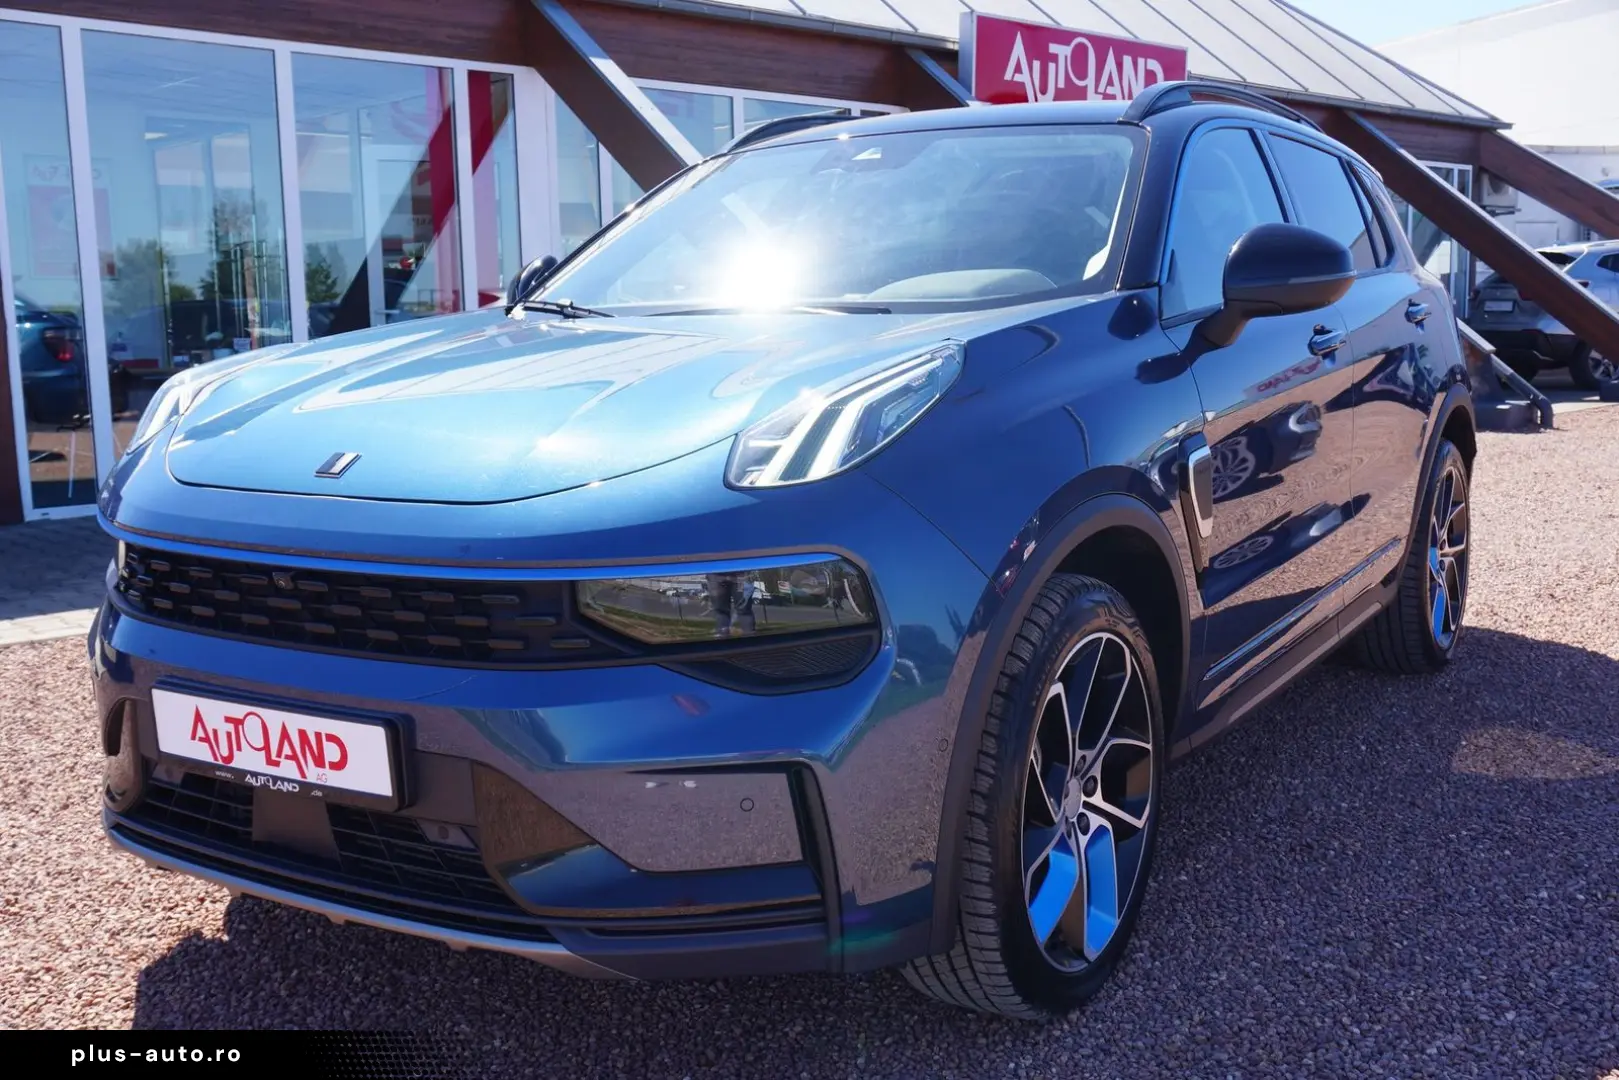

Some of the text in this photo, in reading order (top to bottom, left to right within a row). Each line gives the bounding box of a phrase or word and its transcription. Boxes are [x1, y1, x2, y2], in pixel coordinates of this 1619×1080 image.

[190, 704, 348, 780] AUTOLAND
[215, 770, 235, 779] www.
[245, 773, 300, 793] AUTOLAND
[316, 773, 328, 784] AG
